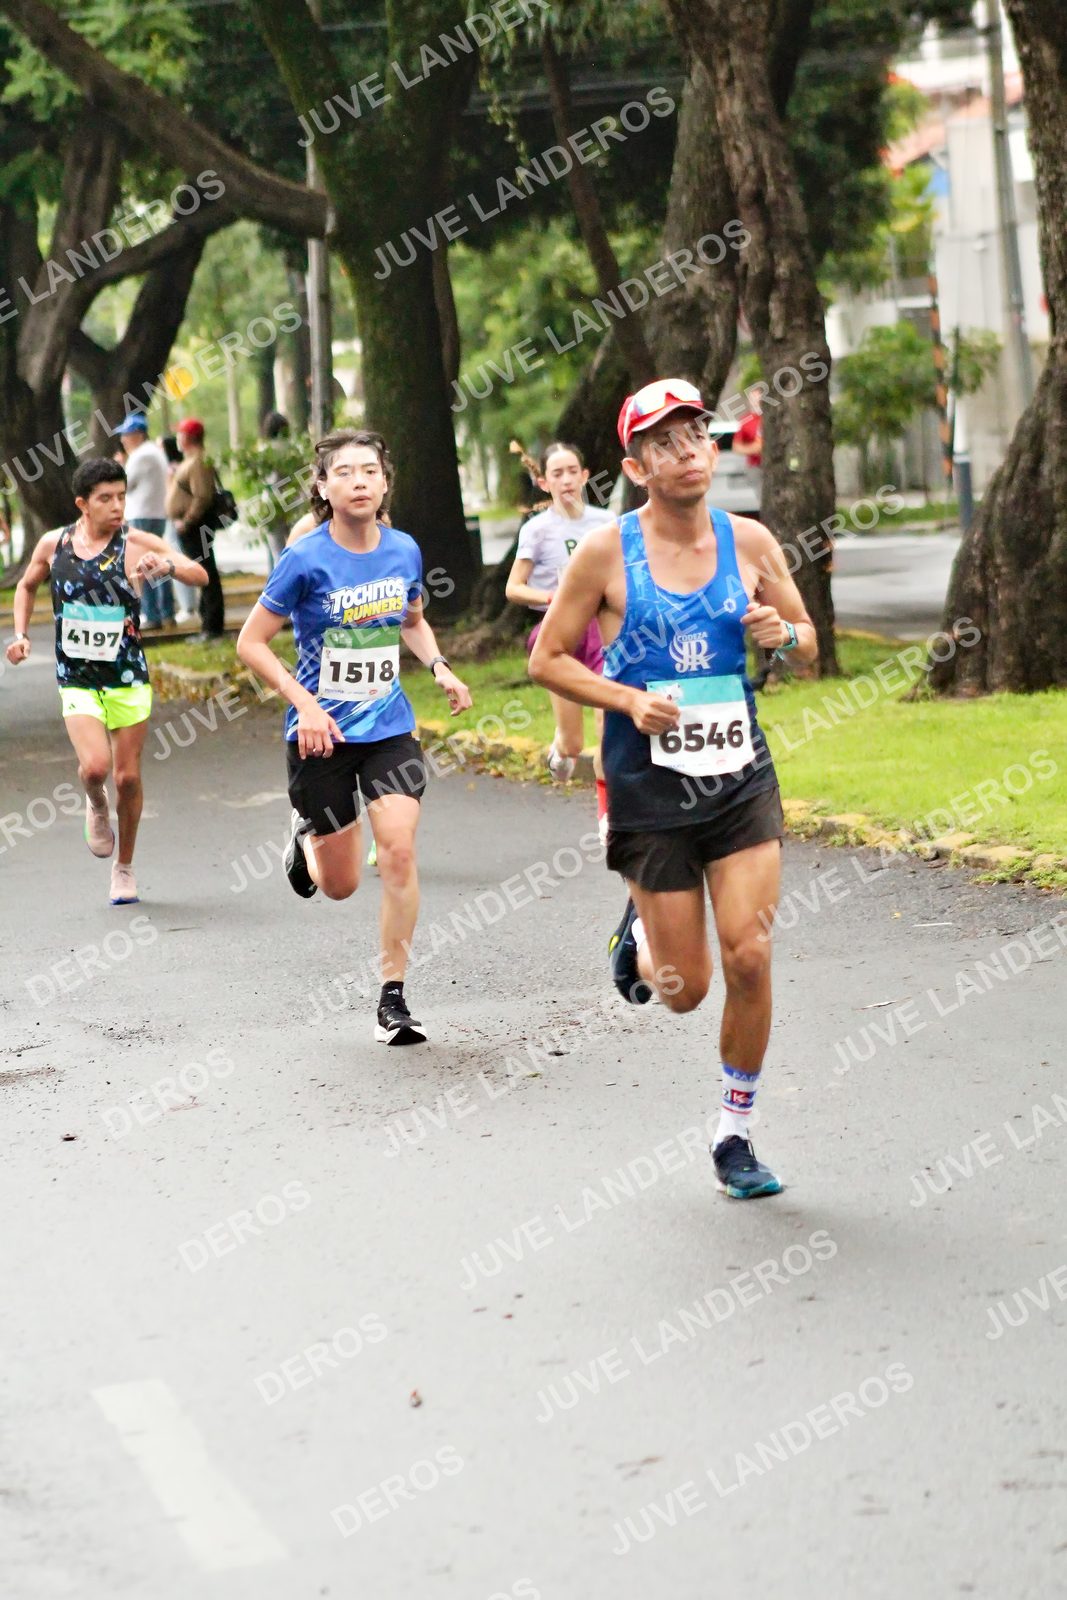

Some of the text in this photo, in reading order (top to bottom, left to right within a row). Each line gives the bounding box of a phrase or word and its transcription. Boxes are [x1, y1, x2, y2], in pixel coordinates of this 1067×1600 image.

[329, 579, 404, 615] TOCHITOS
[342, 596, 403, 625] RUNNERS
[67, 628, 120, 648] 4197
[677, 631, 709, 642] CODEZA
[329, 659, 395, 684] 1518
[658, 719, 744, 754] 6546
